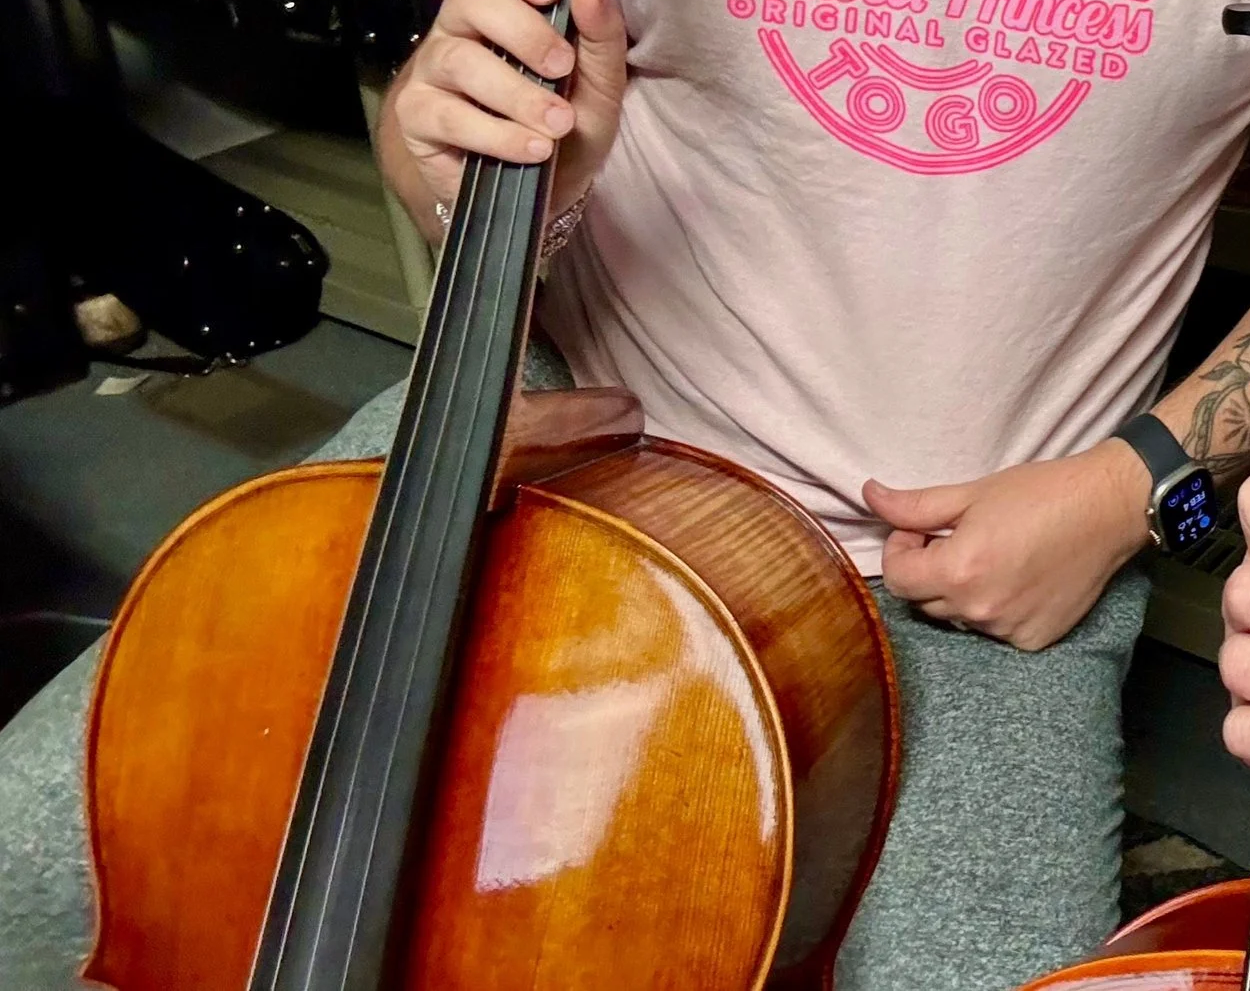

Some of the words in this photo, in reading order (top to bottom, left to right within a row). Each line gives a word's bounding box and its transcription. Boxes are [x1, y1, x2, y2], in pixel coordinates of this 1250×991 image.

[807, 37, 907, 135] TO
[924, 74, 1038, 152] GO
[964, 26, 1129, 81] GLAZED
